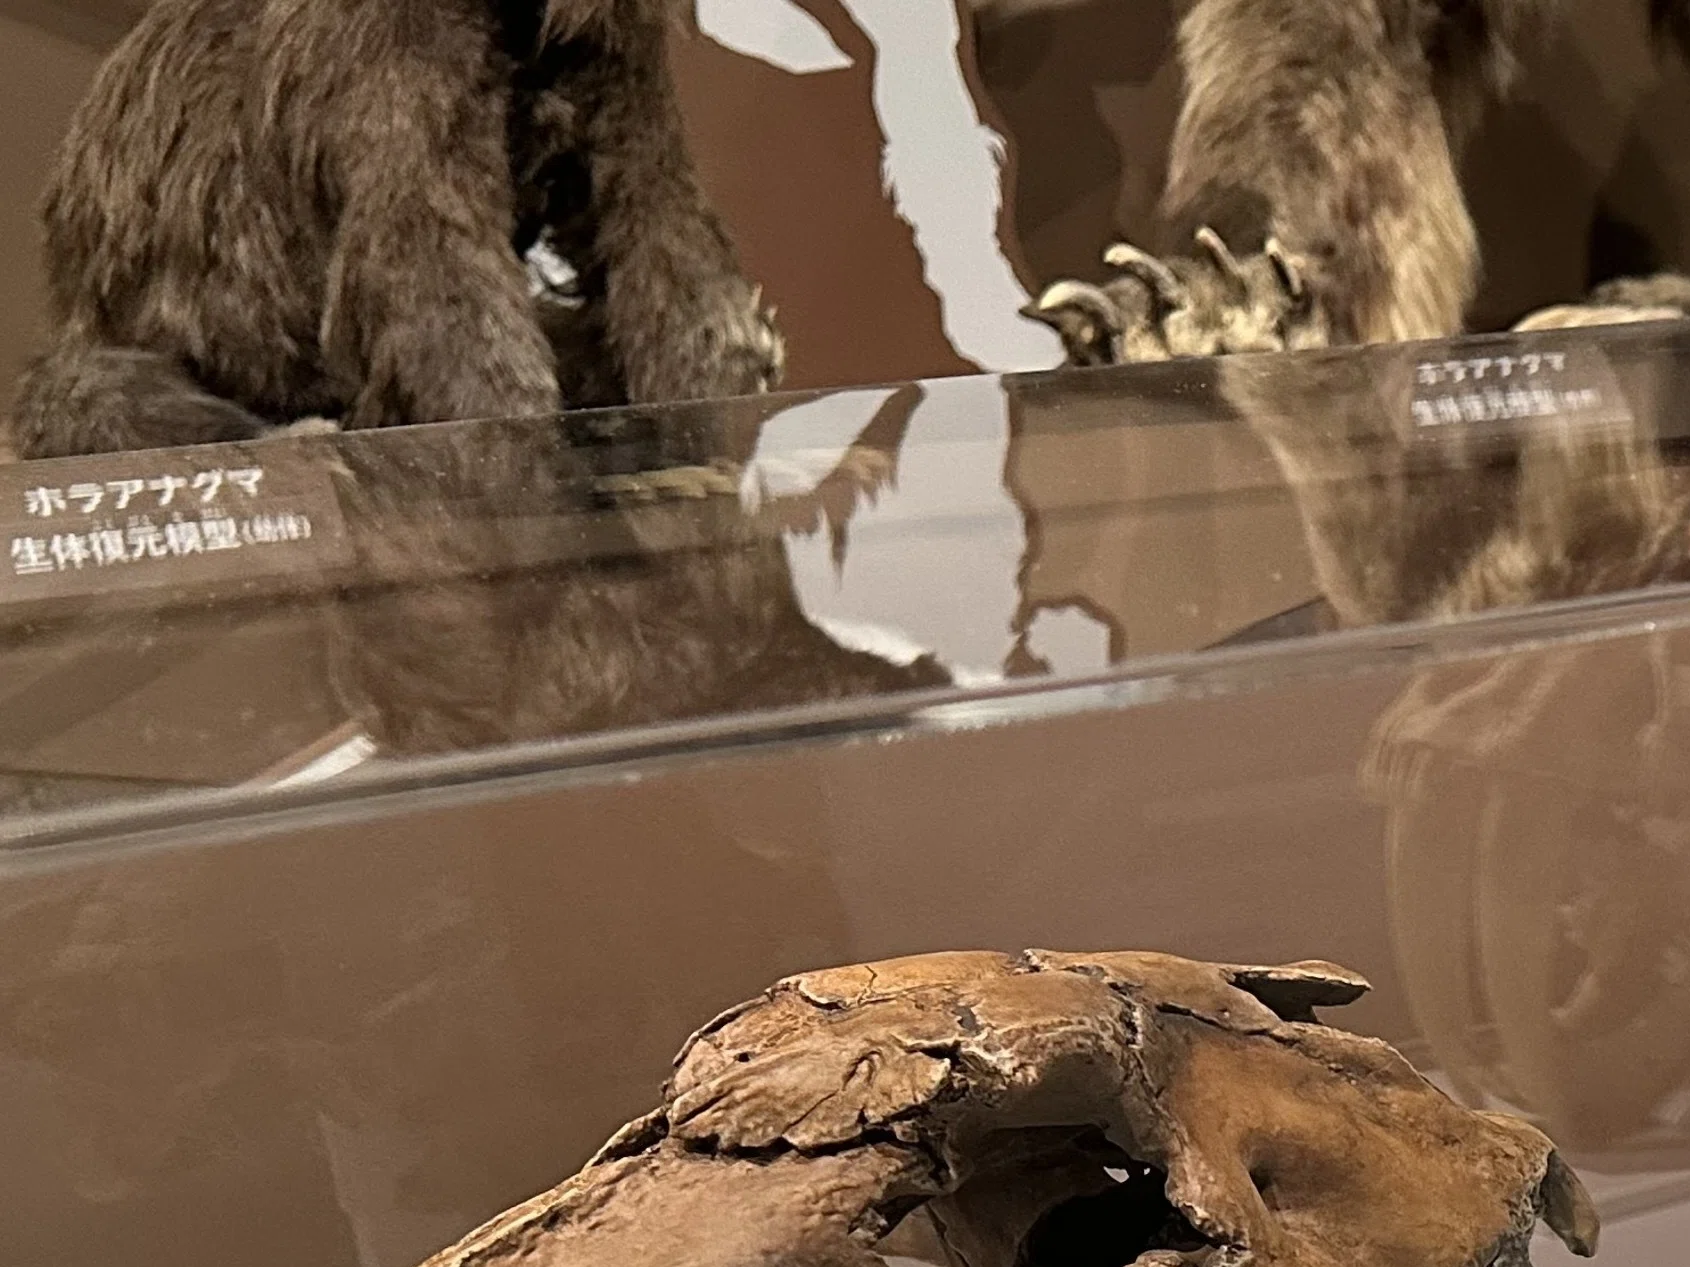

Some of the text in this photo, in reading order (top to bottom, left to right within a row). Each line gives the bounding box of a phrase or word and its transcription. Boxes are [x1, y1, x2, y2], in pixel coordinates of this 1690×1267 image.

[23, 466, 264, 517] ホラアナグマ
